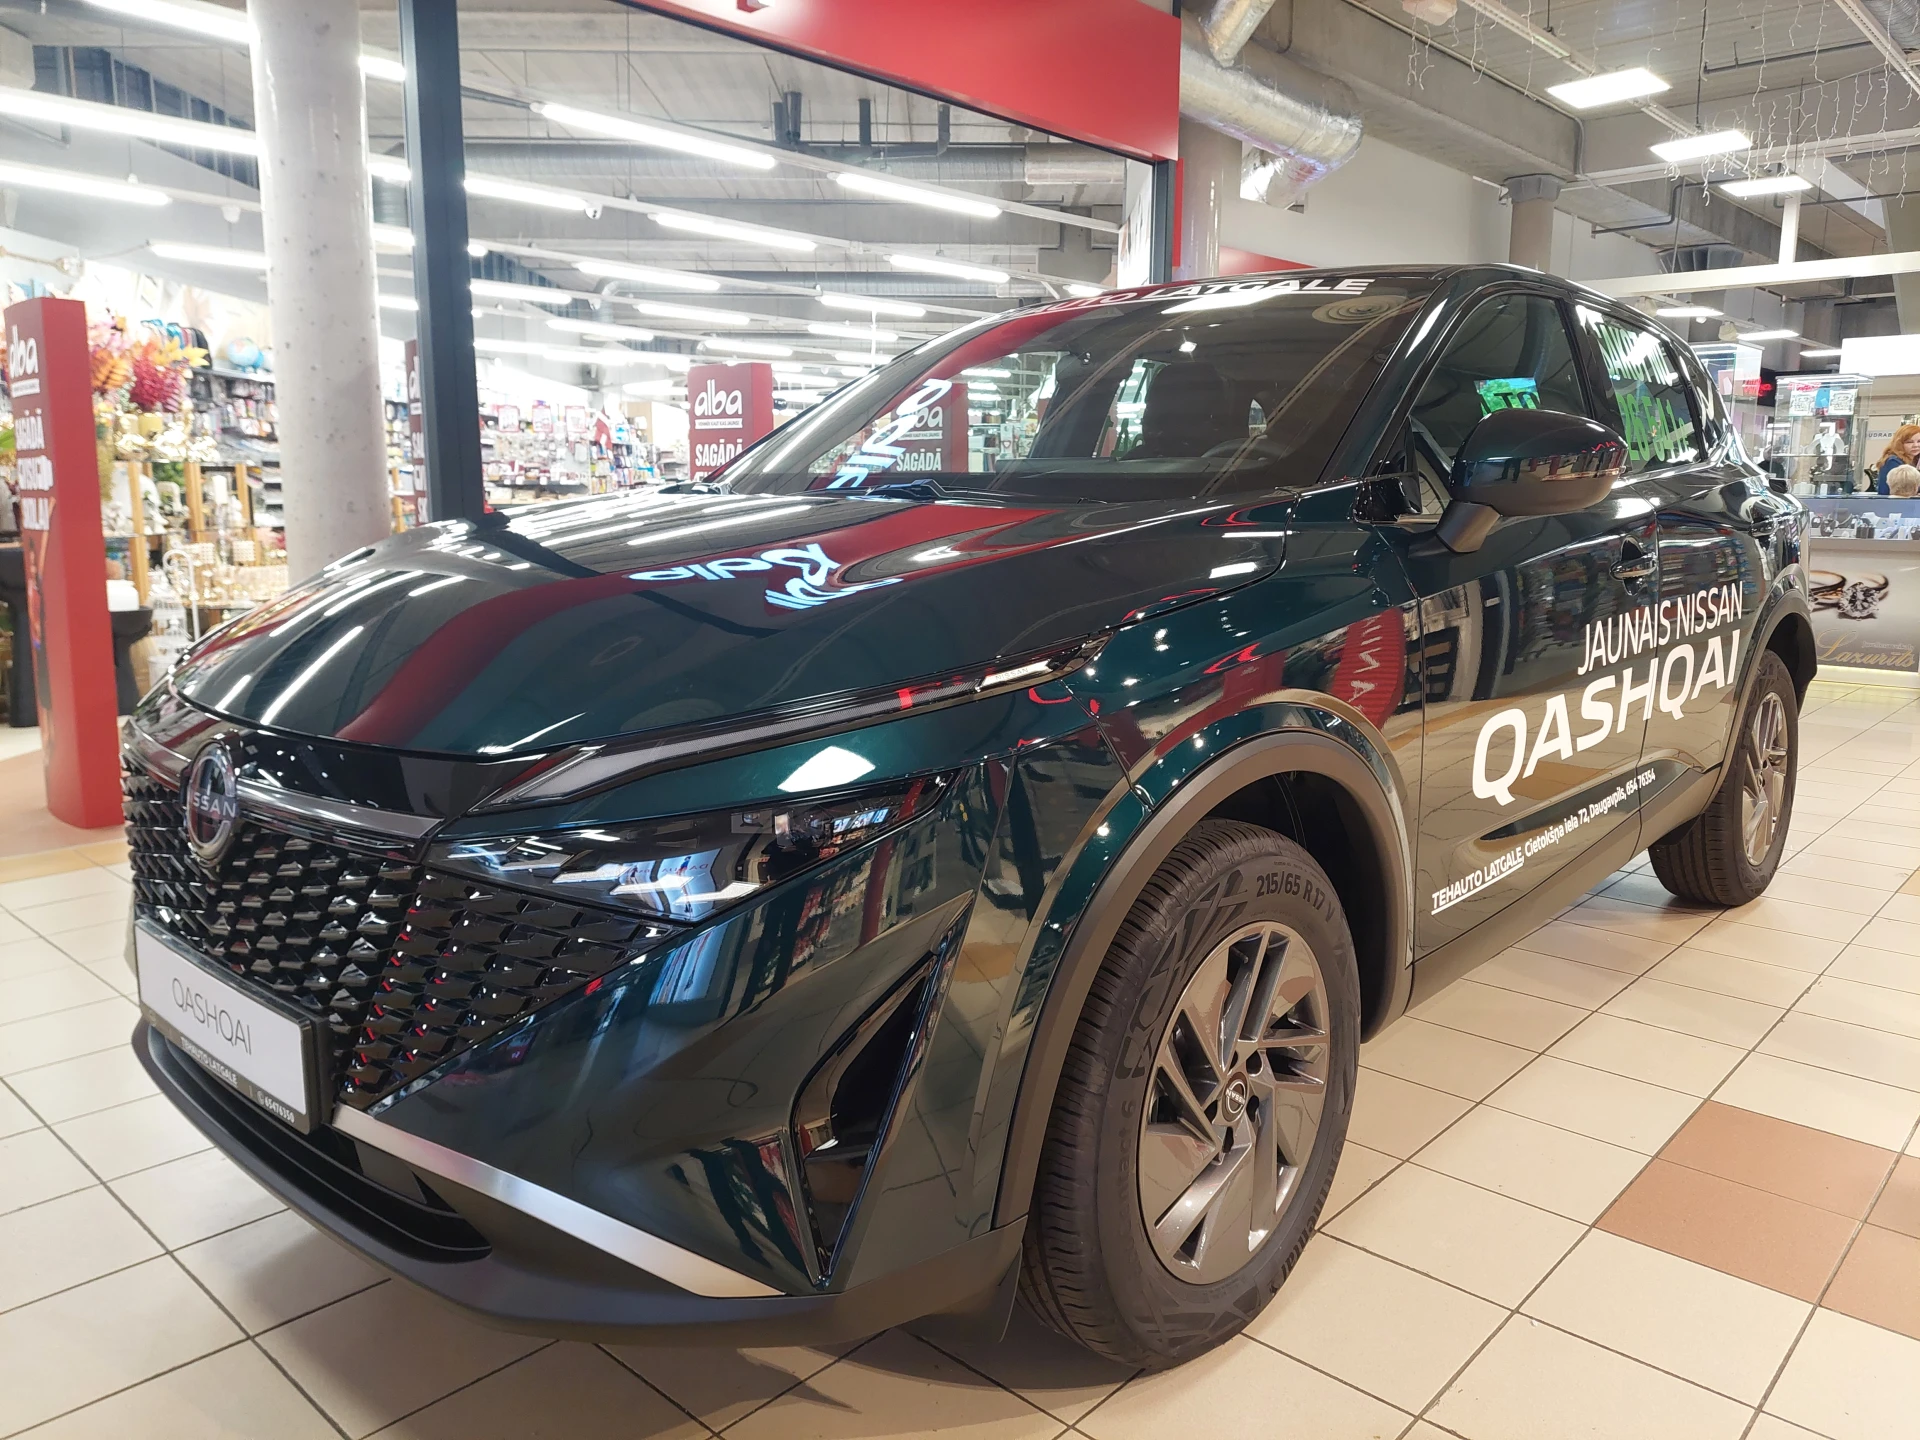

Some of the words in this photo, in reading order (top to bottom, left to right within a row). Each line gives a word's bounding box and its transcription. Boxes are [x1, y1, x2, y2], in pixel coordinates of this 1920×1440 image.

[1140, 278, 1376, 299] LATGALE
[694, 379, 742, 416] alba
[695, 438, 743, 467] SAGĀDĀ
[896, 448, 942, 471] SAGĀDĀ
[1577, 600, 1671, 676] JAUNAIS
[1676, 581, 1743, 640] NISSAN
[1472, 629, 1741, 806] QASHQAI
[192, 790, 237, 818] SSAN
[1431, 869, 1483, 910] TEHAUTO
[1525, 826, 1565, 857] Cietokšņa
[1564, 814, 1579, 834] iela
[1578, 808, 1591, 824] 72,
[1626, 779, 1639, 796] 654
[1256, 871, 1301, 898] 215/65
[1302, 879, 1313, 903] R
[1312, 887, 1326, 911] 17
[1325, 901, 1336, 923] V
[172, 977, 252, 1055] QASHQAI
[208, 1058, 238, 1087] LATGALE
